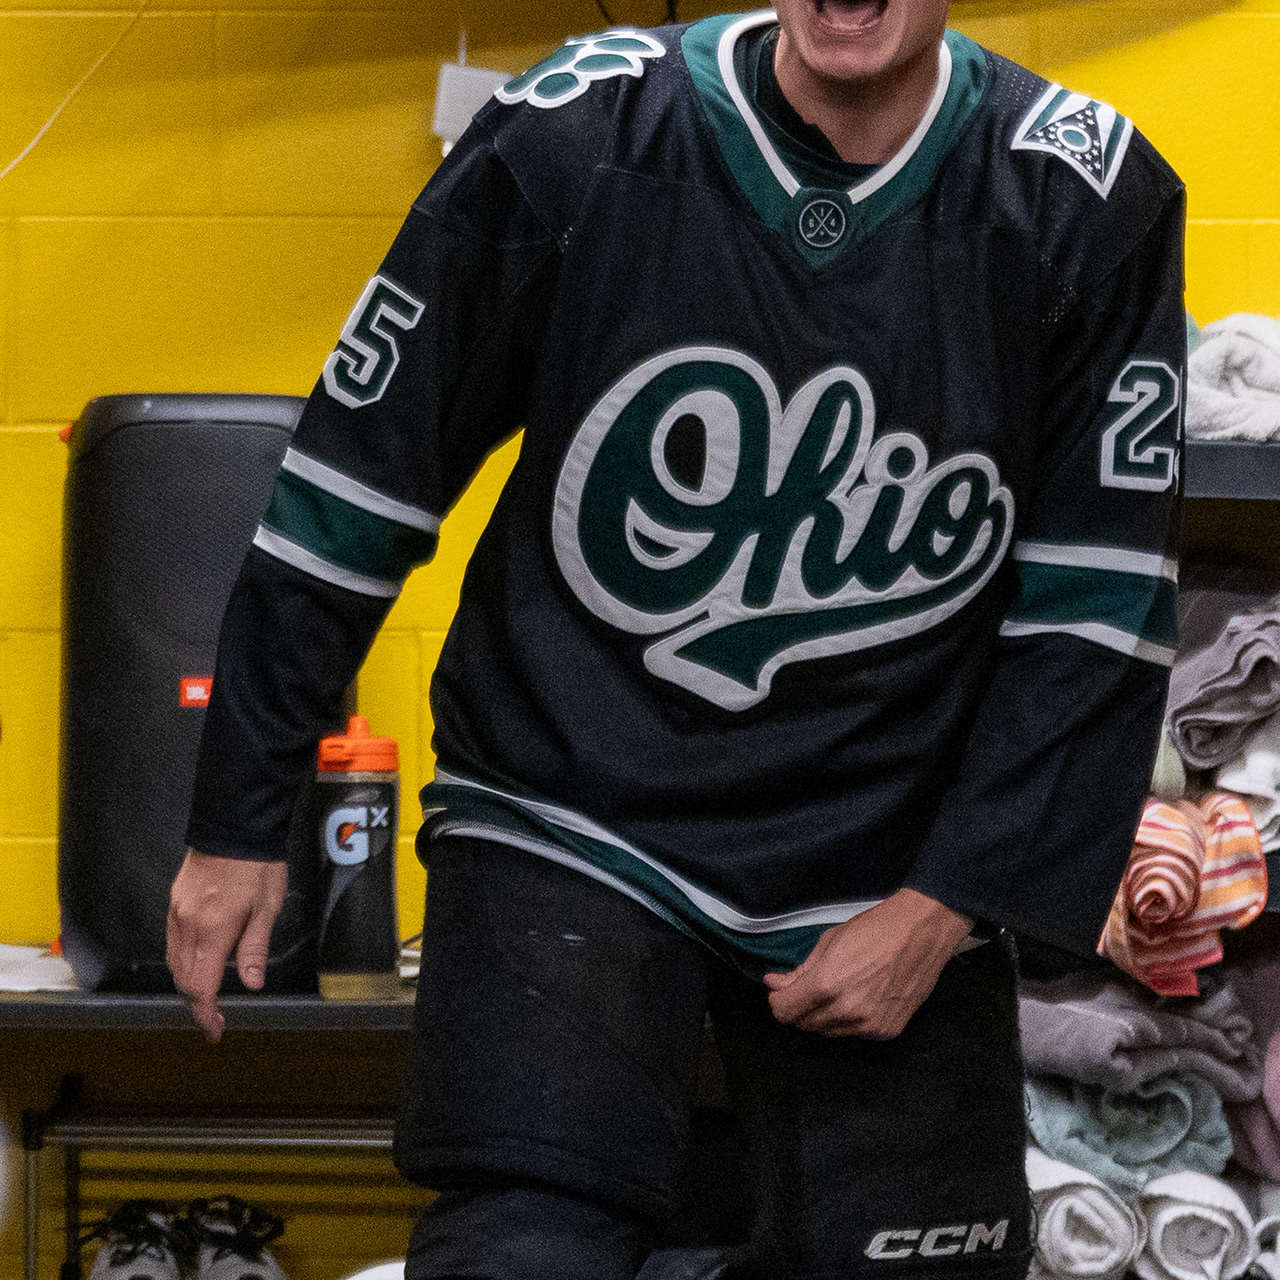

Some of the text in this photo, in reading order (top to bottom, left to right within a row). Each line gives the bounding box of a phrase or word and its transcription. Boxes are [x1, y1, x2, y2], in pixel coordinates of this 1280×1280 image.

[322, 275, 425, 410] 5
[1100, 360, 1184, 496] 2
[552, 346, 1015, 710] Ohio
[863, 1219, 1010, 1260] CCM
